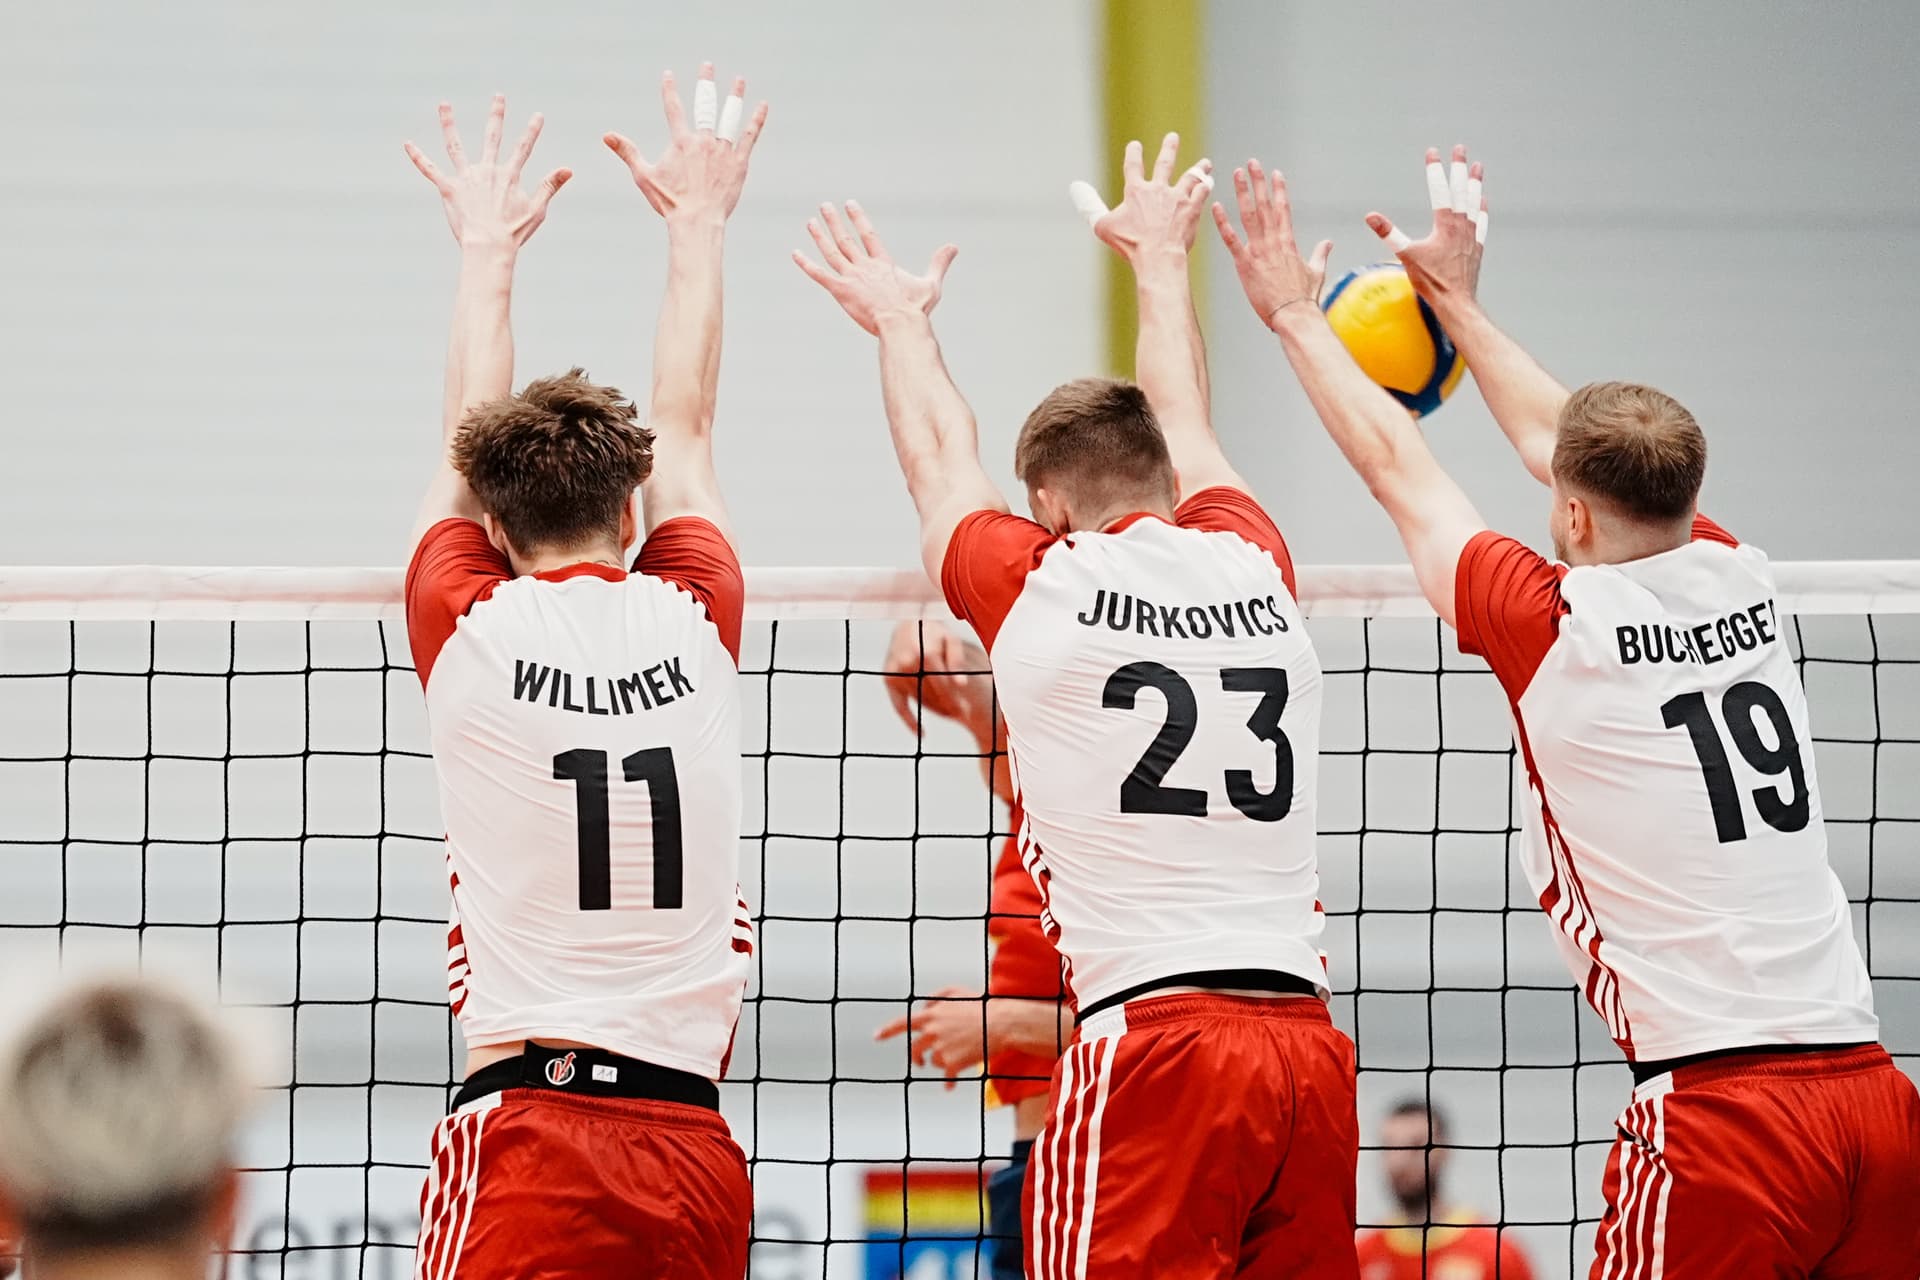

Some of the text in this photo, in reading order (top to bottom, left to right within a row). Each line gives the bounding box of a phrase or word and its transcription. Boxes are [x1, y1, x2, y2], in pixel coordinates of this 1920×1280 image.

[1077, 589, 1289, 640] JURKOVICS
[1616, 598, 1777, 666] BUCHEGGE
[513, 656, 695, 716] WILLIMEK
[1102, 661, 1295, 822] 23
[1660, 681, 1810, 844] 19
[552, 746, 684, 911] 11
